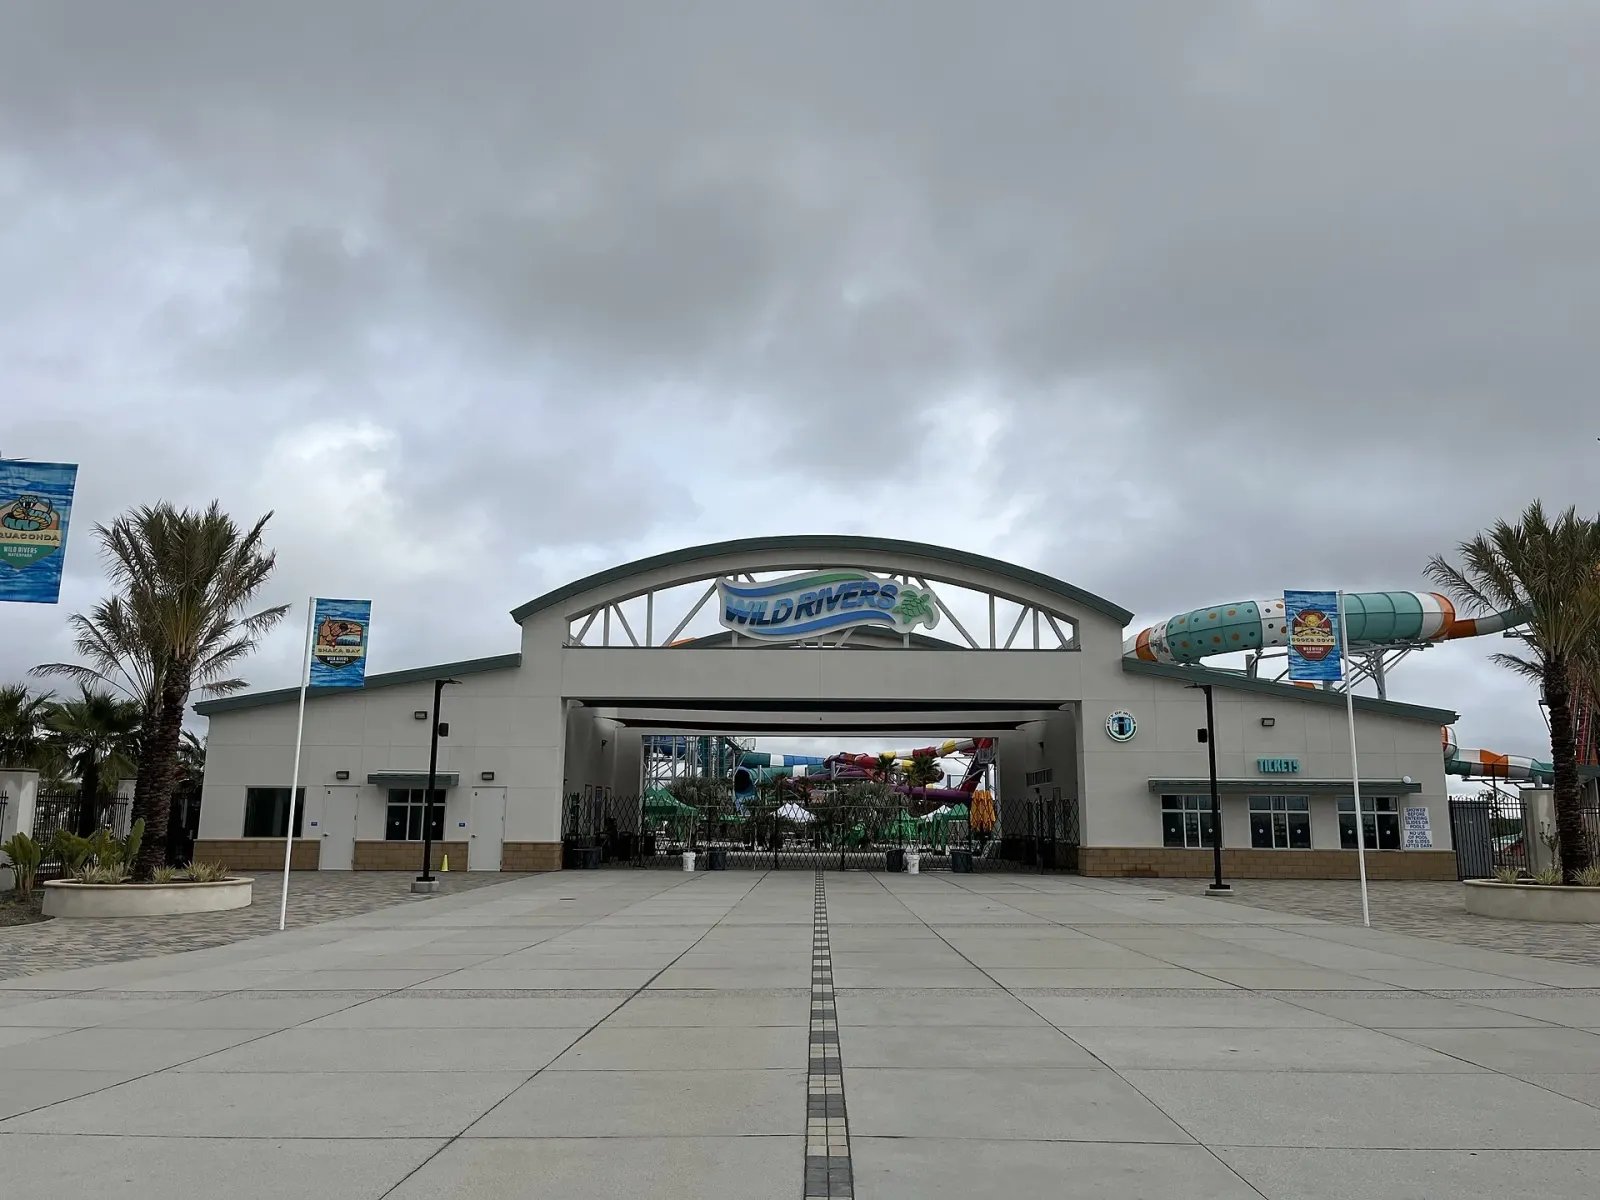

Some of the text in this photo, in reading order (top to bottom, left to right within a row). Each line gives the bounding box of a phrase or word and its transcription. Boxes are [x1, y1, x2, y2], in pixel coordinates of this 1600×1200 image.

[0, 532, 60, 541] QUACONDA
[725, 581, 899, 626] WILD RIVERS
[1257, 758, 1300, 773] TICKETS
